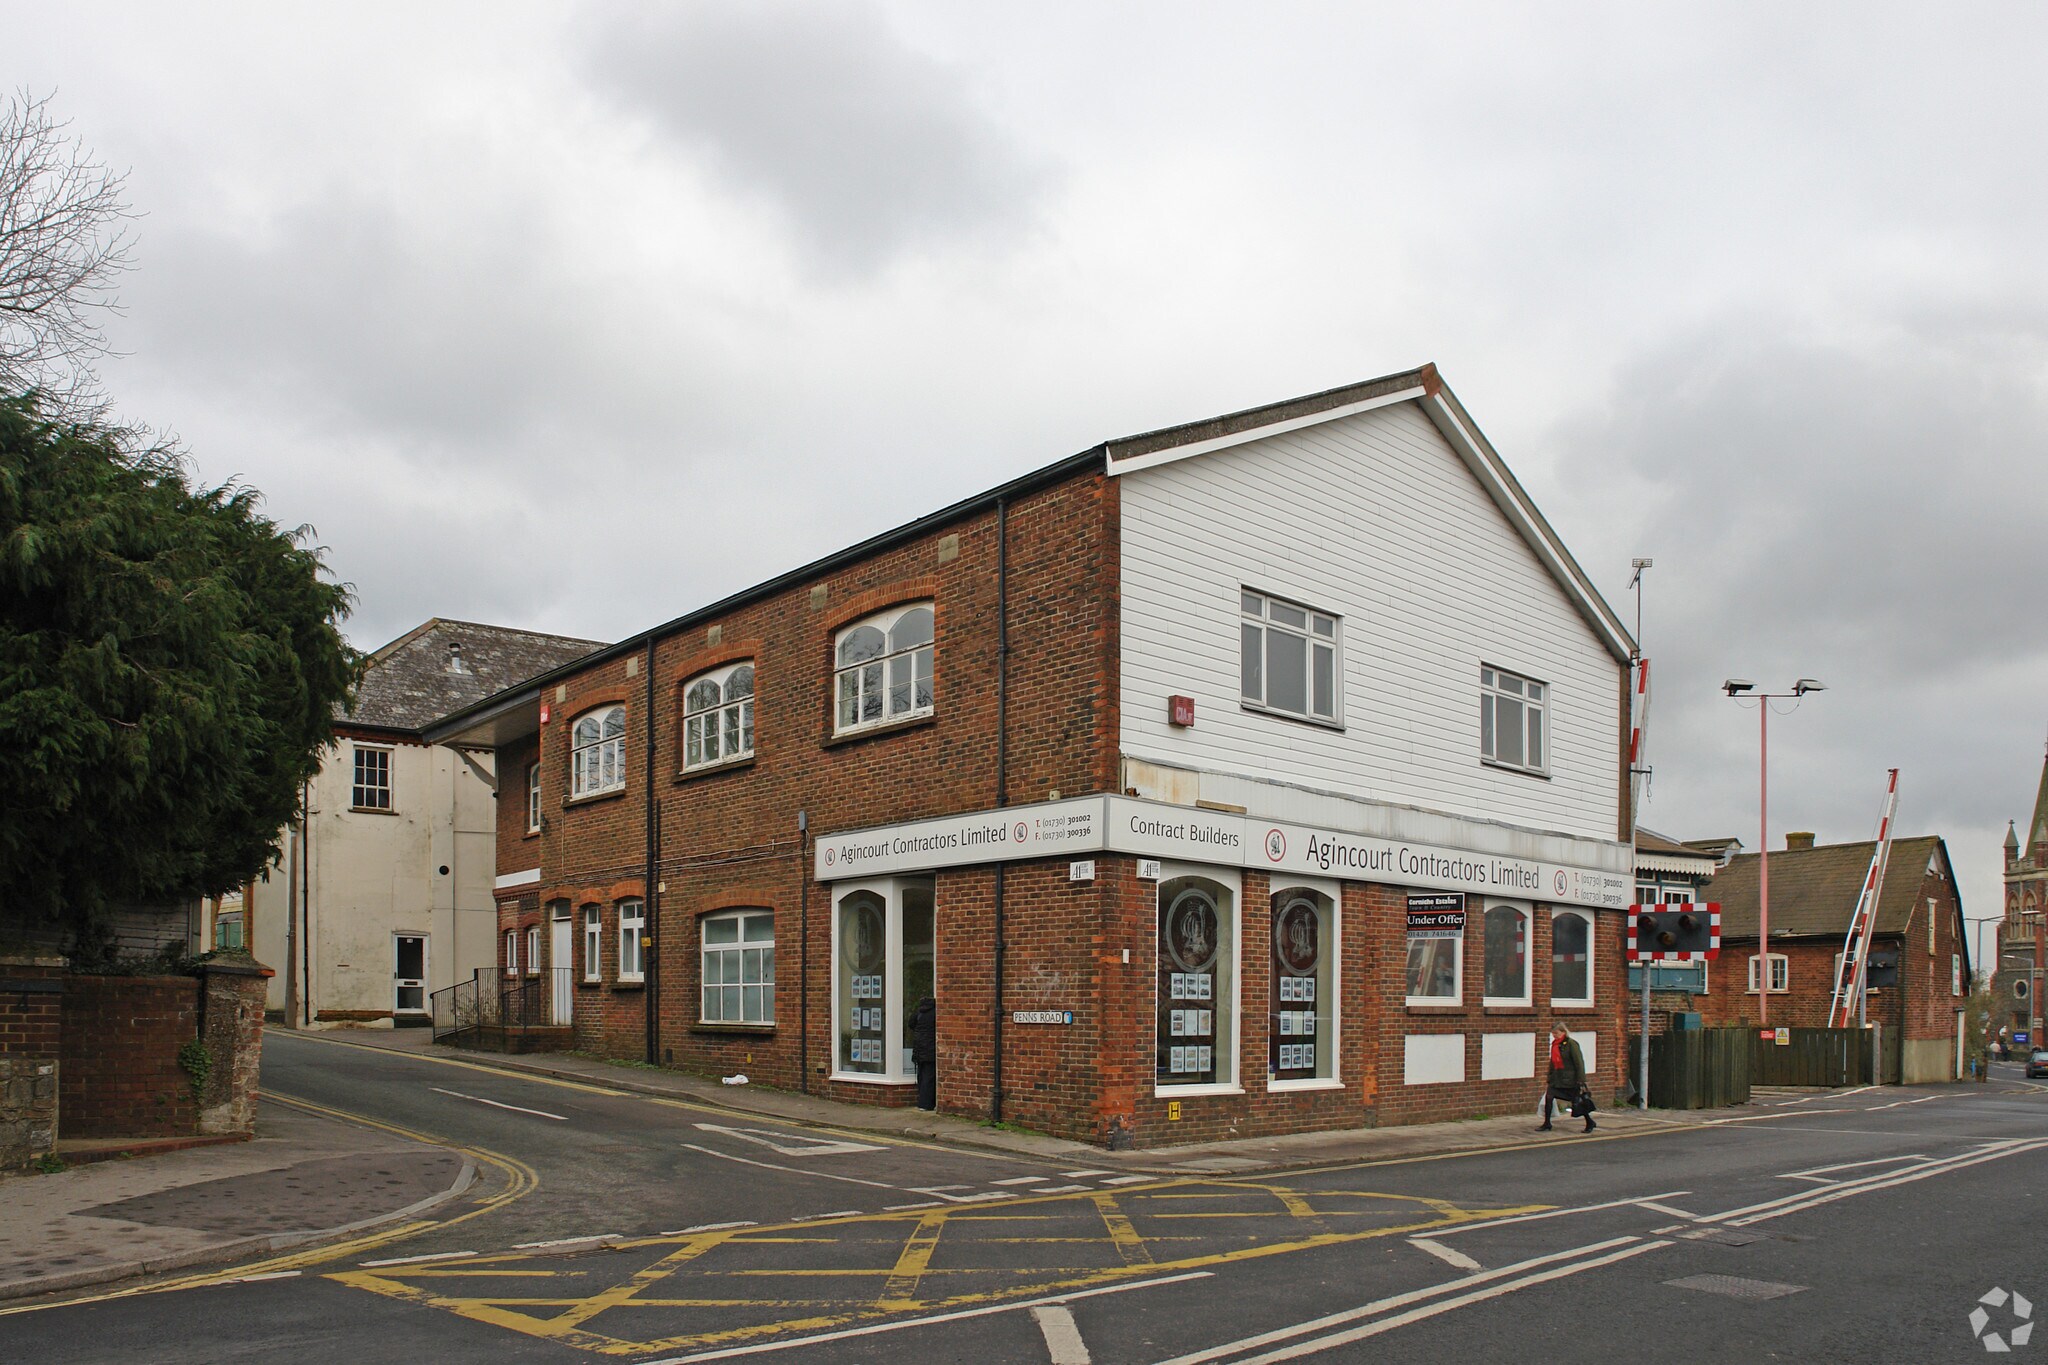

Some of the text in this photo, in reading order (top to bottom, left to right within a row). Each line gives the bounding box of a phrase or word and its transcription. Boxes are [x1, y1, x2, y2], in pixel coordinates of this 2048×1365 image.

[1042, 815, 1066, 828] (01730)
[1067, 814, 1091, 826] 301002
[1042, 828, 1066, 841] (01730)
[1067, 825, 1092, 839] 300336
[1130, 815, 1239, 847] Contract Builders
[840, 822, 1007, 865] Agincourt Contractors Limited
[1306, 834, 1540, 889] Agincourt Contractors Limited
[1603, 878, 1623, 888] 301002
[1602, 893, 1623, 905] 300336
[1407, 914, 1464, 925] Under Offer
[1014, 1012, 1062, 1022] PENNS ROAD
[1170, 1104, 1179, 1119] H
